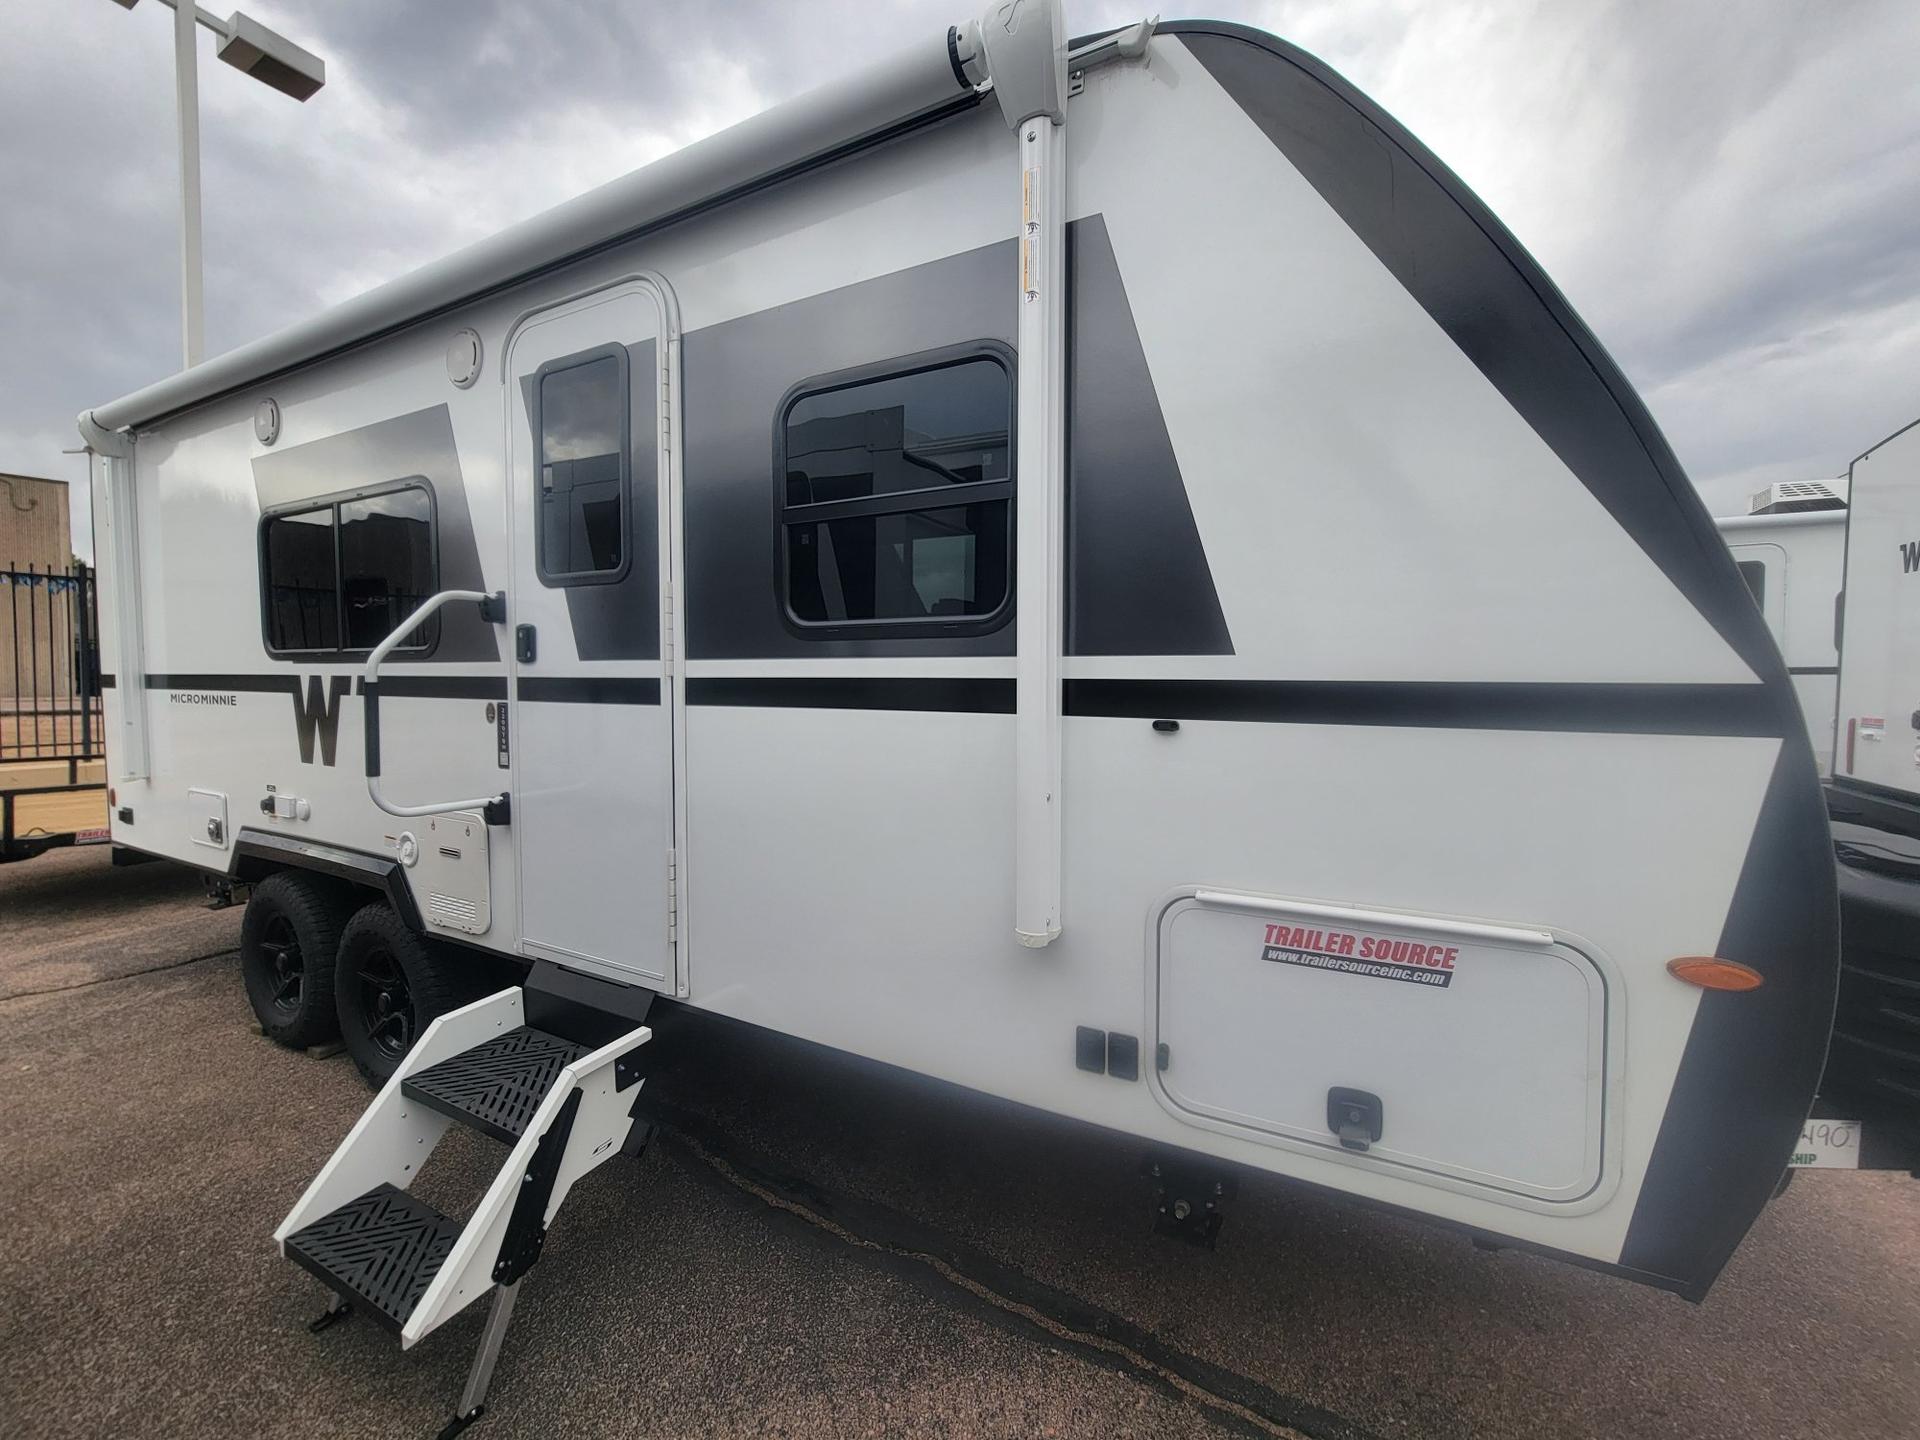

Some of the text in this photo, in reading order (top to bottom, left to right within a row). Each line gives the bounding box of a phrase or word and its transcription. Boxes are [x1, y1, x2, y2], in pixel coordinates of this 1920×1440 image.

[170, 693, 237, 706] MICROMINNIE
[292, 675, 351, 767] W
[1264, 924, 1459, 969] TRAILER SOURCE
[1267, 949, 1446, 985] www.trailersourceinc.com
